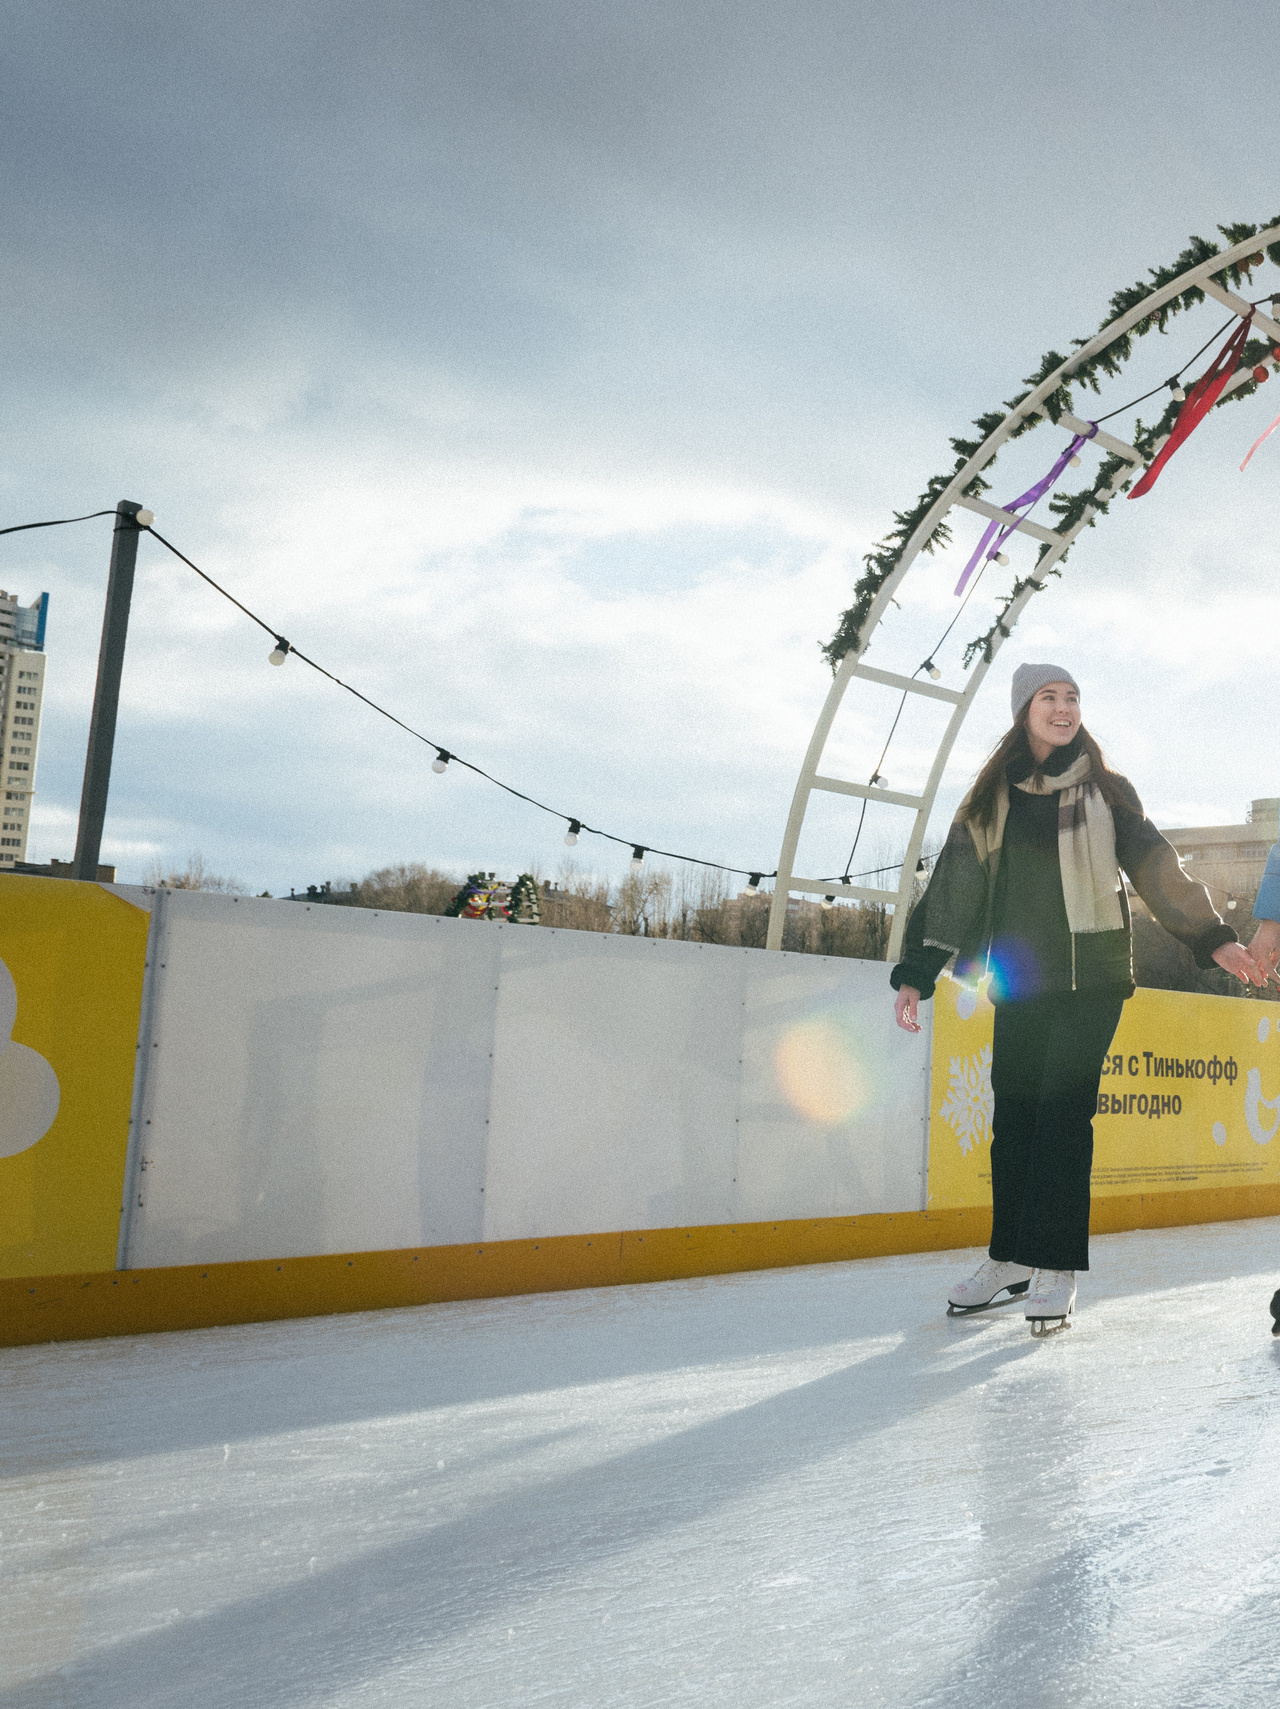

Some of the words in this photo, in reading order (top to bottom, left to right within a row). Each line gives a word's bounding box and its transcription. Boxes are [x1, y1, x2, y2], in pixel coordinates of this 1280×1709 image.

[1100, 1054, 1123, 1076] ся
[1127, 1055, 1139, 1077] с
[1142, 1051, 1238, 1086] Тинькофф
[1097, 1093, 1182, 1119] выгодно
